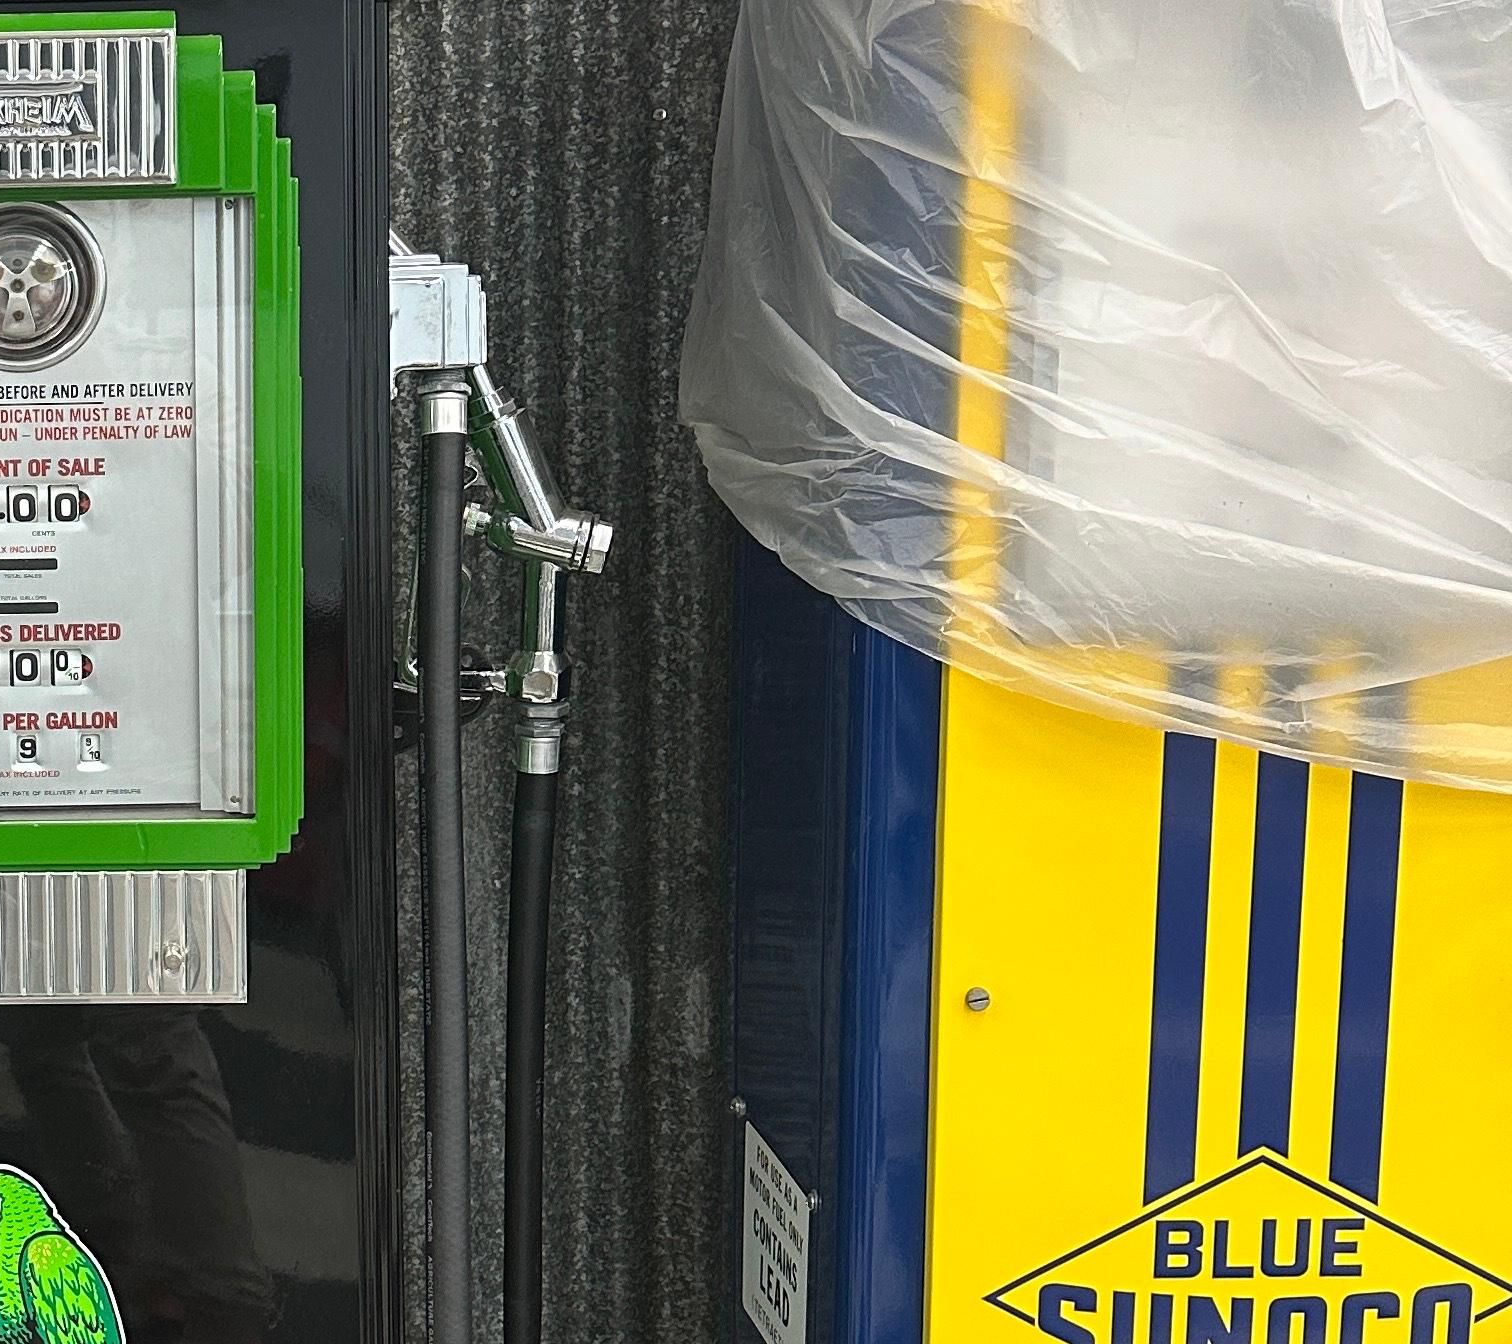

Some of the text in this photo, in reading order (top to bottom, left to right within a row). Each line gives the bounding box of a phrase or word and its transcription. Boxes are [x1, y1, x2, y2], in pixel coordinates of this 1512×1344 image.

[51, 384, 78, 399] AND
[84, 383, 124, 398] AFTER
[130, 382, 193, 397] DELIVERY
[70, 408, 109, 422] MUST
[115, 407, 131, 421] BE
[137, 406, 153, 421] AT
[159, 406, 193, 420] ZERO
[35, 426, 78, 441] UNDER
[83, 425, 139, 440] PENALTY
[145, 425, 159, 439] OF
[164, 424, 192, 438] LAW
[28, 459, 52, 477] OF
[58, 458, 105, 476] SALE
[10, 545, 56, 553] INCLUDED
[19, 623, 121, 641] DELIVERED
[3, 713, 40, 730] PER
[46, 711, 117, 729] GALLON
[19, 738, 36, 758] 9
[13, 770, 60, 778] INCLUDED
[757, 1145, 798, 1216] FOR USE AS A
[750, 1166, 803, 1255] MOTOR FUEL ONLY
[753, 1208, 798, 1293] CONTAINS
[1153, 1218, 1365, 1279] BLUE
[760, 1254, 789, 1327] LEAD
